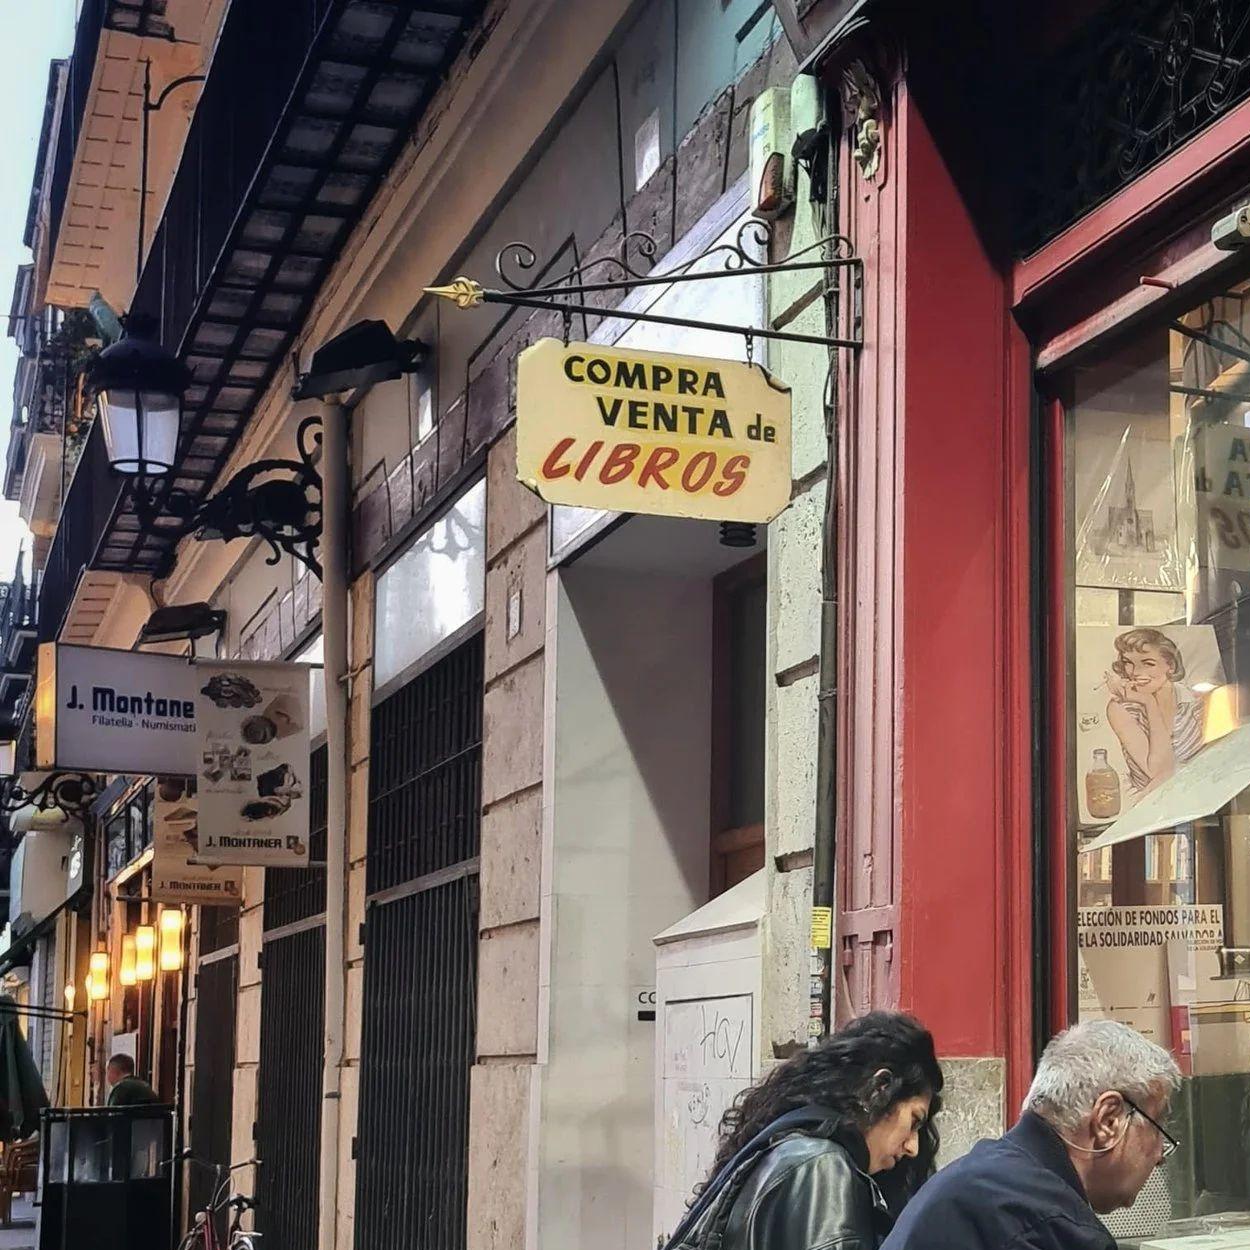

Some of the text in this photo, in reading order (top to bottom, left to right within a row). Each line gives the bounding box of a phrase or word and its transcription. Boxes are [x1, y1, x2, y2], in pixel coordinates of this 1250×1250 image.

[564, 355, 726, 399] COMPRA
[596, 396, 776, 442] VENTA de
[542, 437, 751, 497] LIBROS
[67, 685, 195, 719] J. Montane
[91, 714, 197, 733] Filatelia Numismati
[205, 836, 282, 848] J. MONTANER
[159, 881, 167, 890] J.
[1125, 911, 1137, 925] DE
[1140, 909, 1179, 926] FONDOS
[1181, 910, 1208, 925] PARA
[1210, 909, 1220, 924] EL
[1085, 932, 1098, 948] LA
[1099, 930, 1163, 948] SOLIDARIDAD
